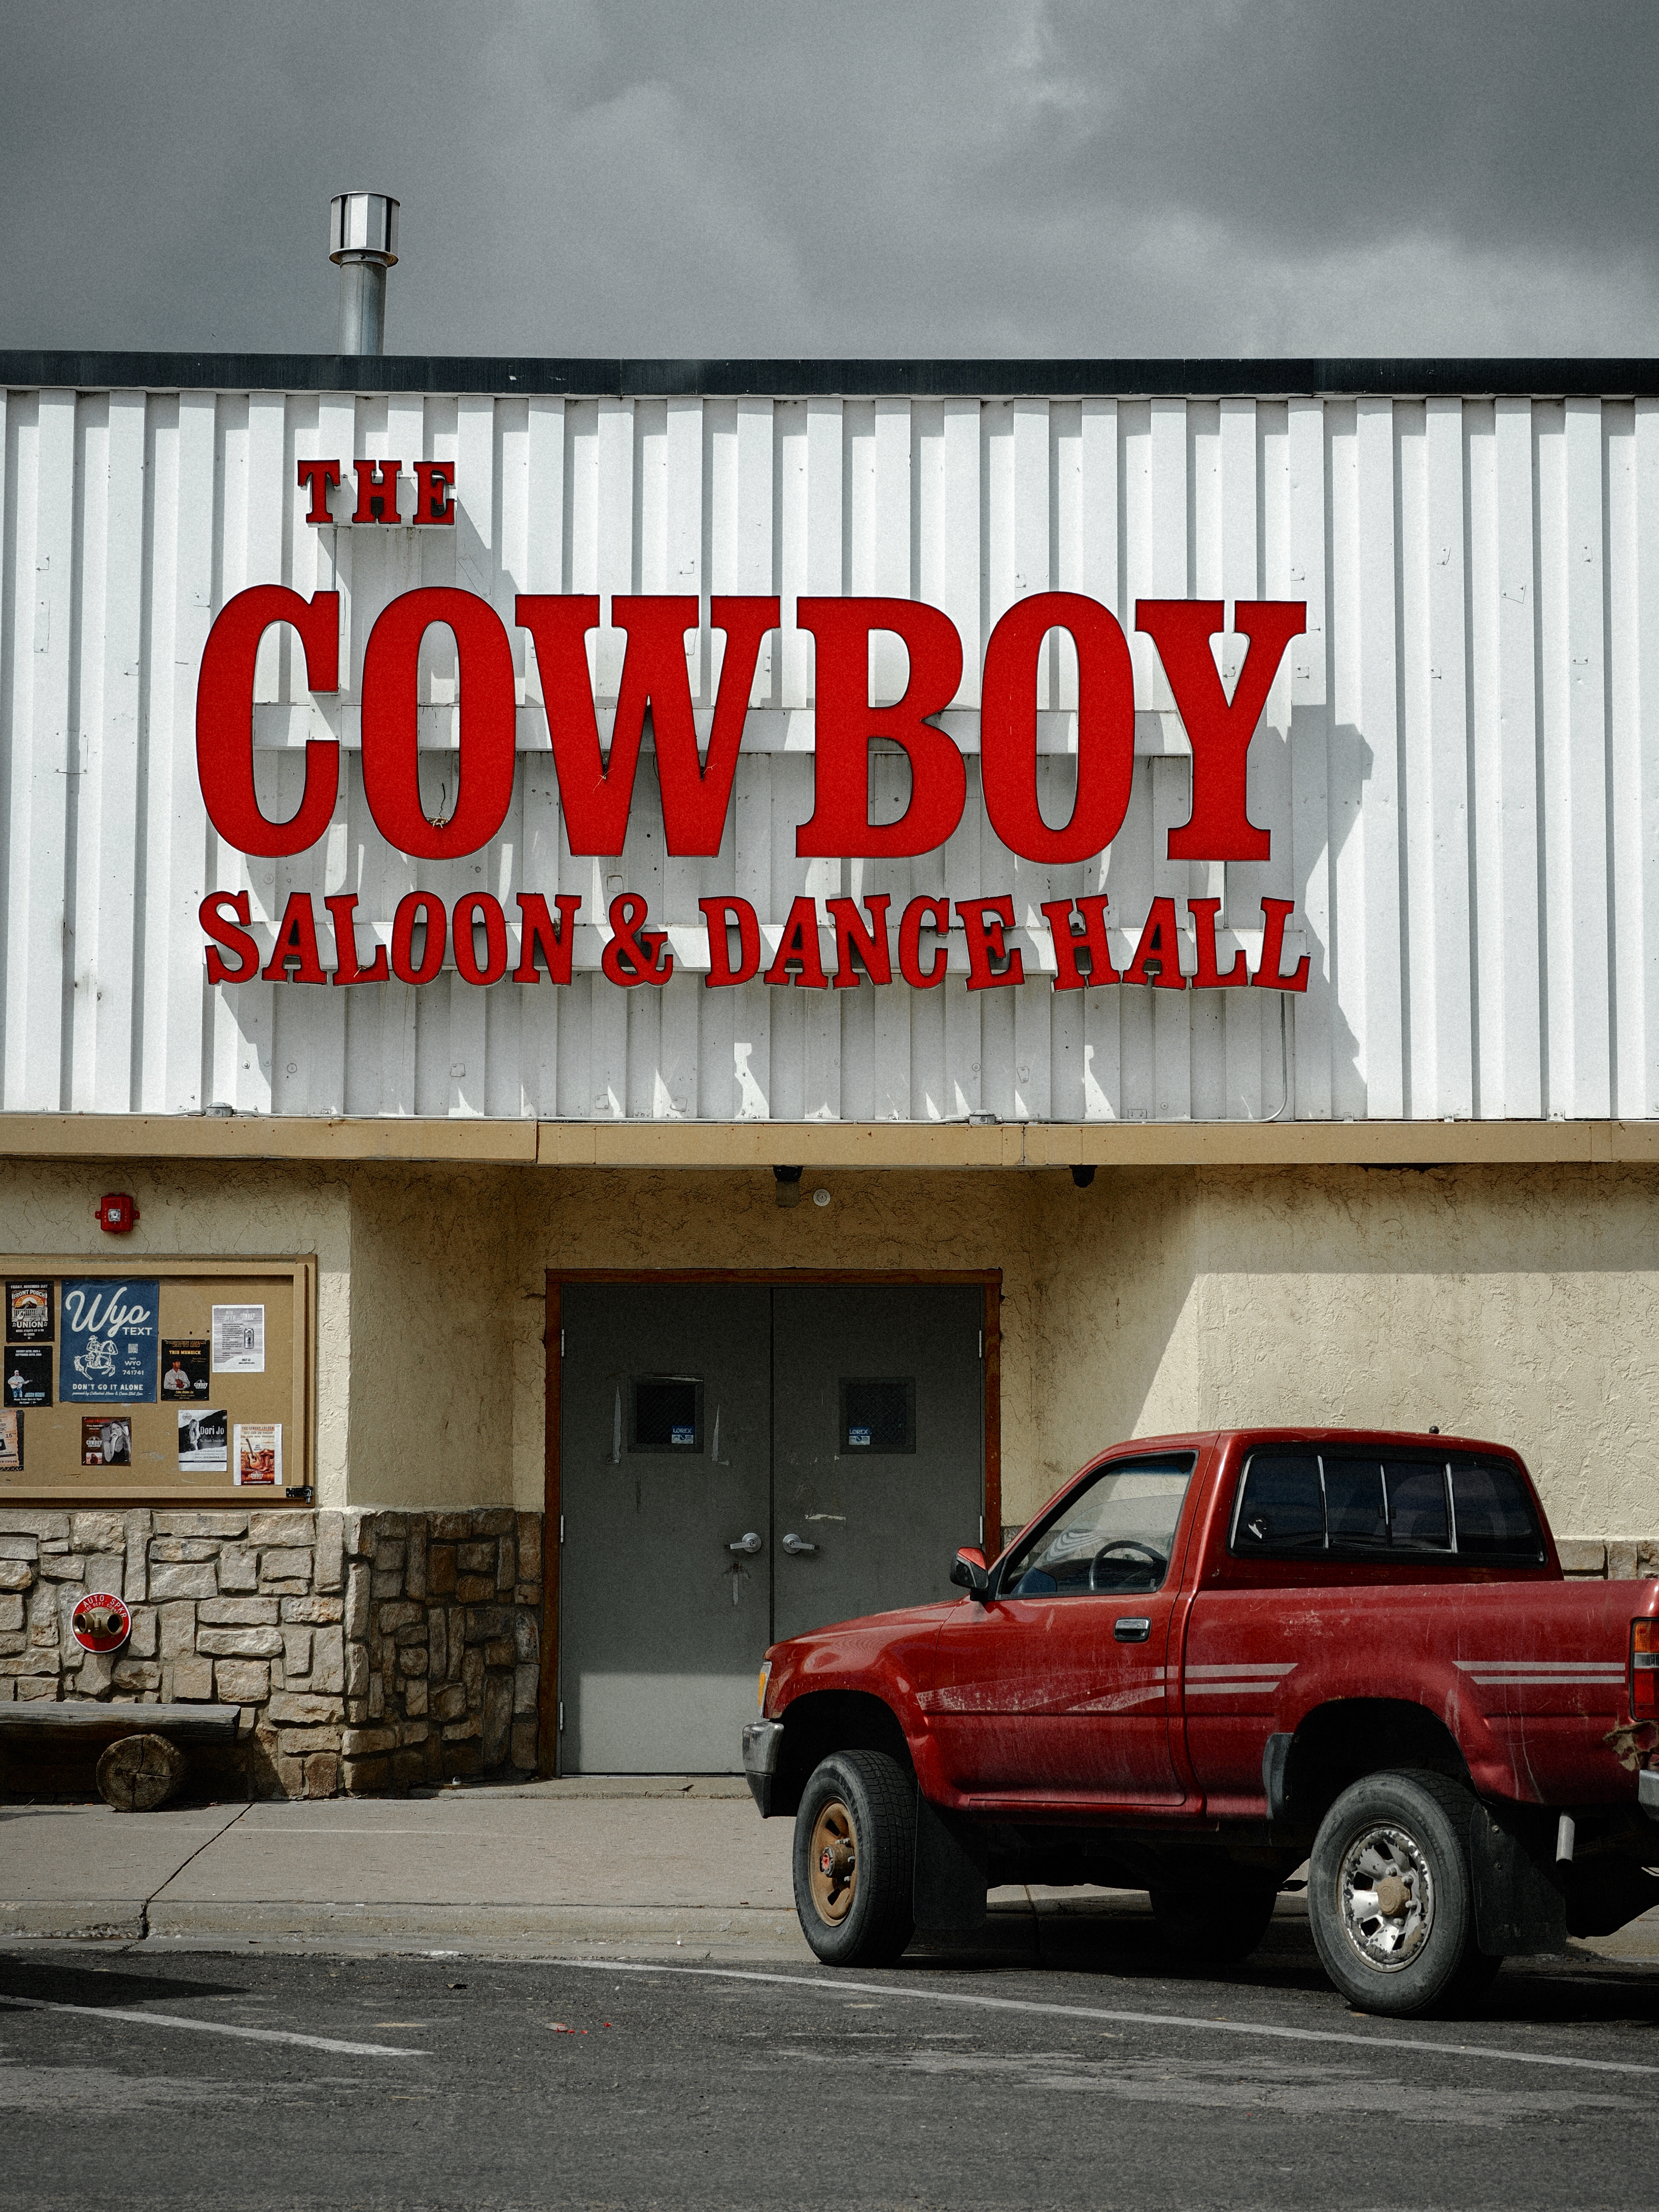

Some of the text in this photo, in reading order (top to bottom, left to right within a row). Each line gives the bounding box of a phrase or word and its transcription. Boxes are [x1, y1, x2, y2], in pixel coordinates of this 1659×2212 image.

[298, 461, 455, 524] THE
[196, 585, 1306, 864] COWBOY
[200, 891, 582, 987] SALOON
[602, 892, 674, 987] &
[14, 1289, 45, 1299] FRONT PORCH
[66, 1287, 150, 1338] Wyo
[122, 1327, 153, 1335] TEXT
[200, 1425, 224, 1435] Dori Jo
[83, 1605, 92, 1613] FIRE
[110, 1599, 127, 1618] SPKR
